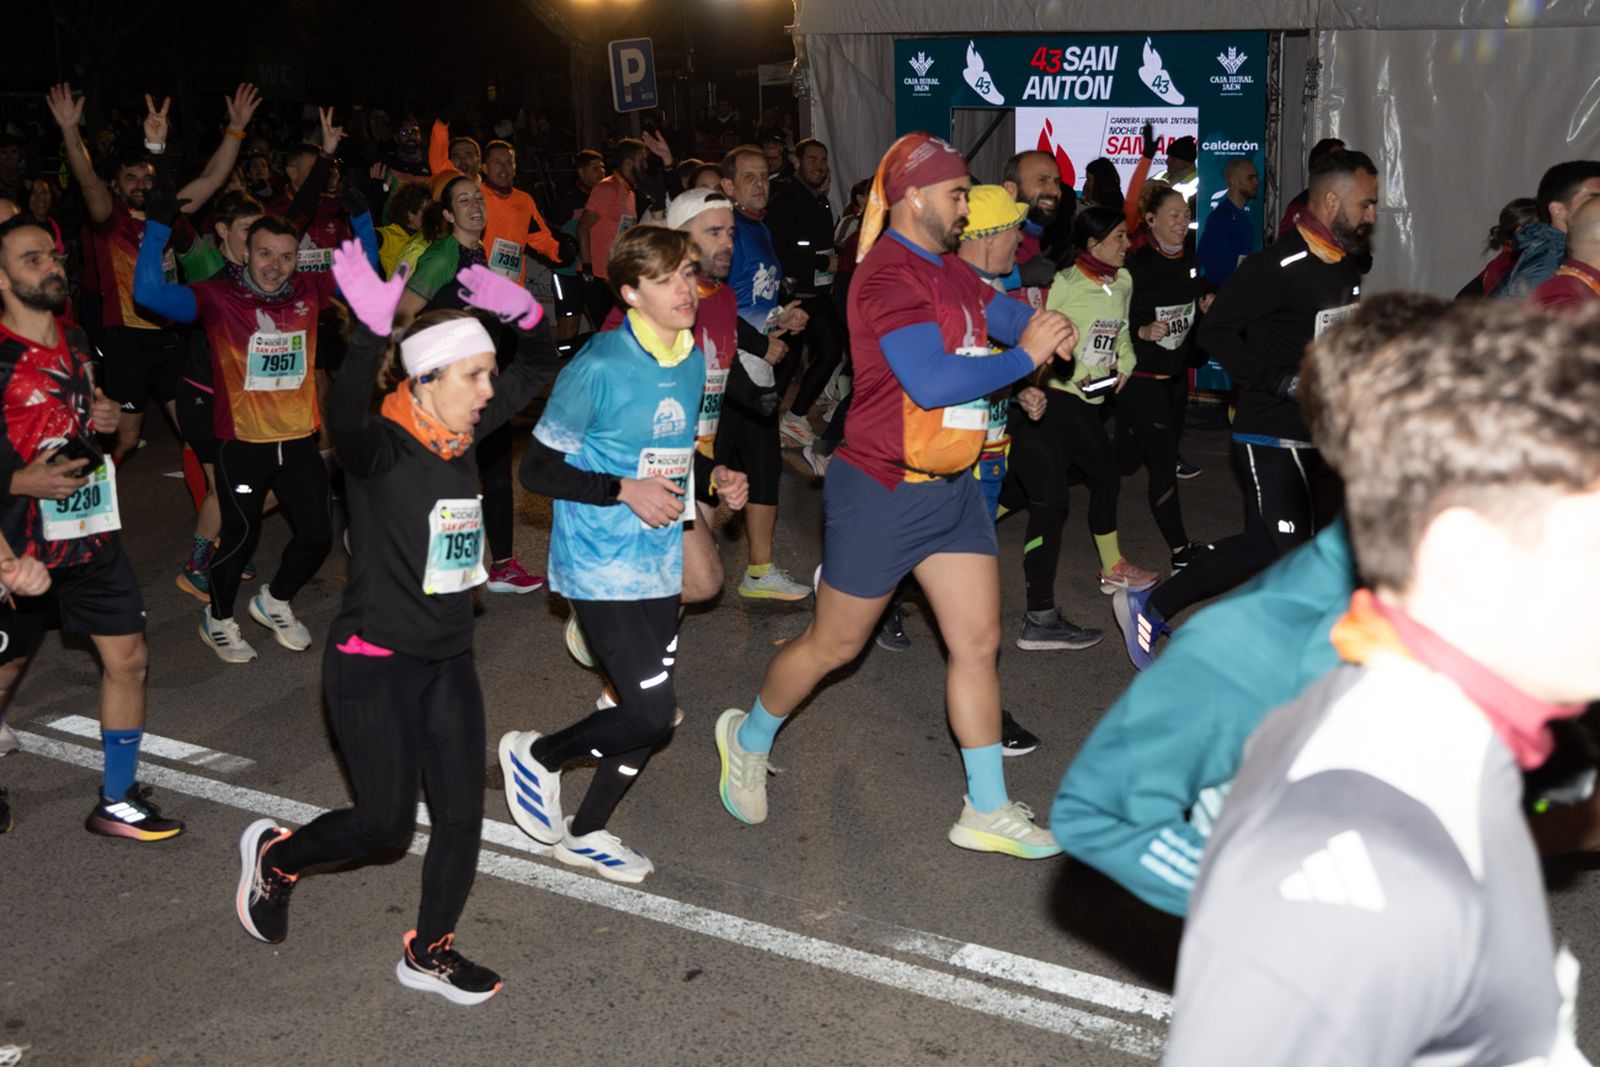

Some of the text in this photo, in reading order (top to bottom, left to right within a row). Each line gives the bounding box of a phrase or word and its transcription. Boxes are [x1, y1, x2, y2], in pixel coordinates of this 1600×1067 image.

[1030, 46, 1119, 74] 43 SAN
[620, 48, 646, 103] P
[1022, 68, 1114, 101] ANTÓN
[1151, 75, 1169, 95] 43
[975, 77, 991, 95] 43
[1109, 126, 1137, 135] NOCHE
[1201, 140, 1259, 151] calderón
[1093, 334, 1116, 351] 671
[261, 353, 296, 372] 7957
[57, 485, 101, 513] 9230
